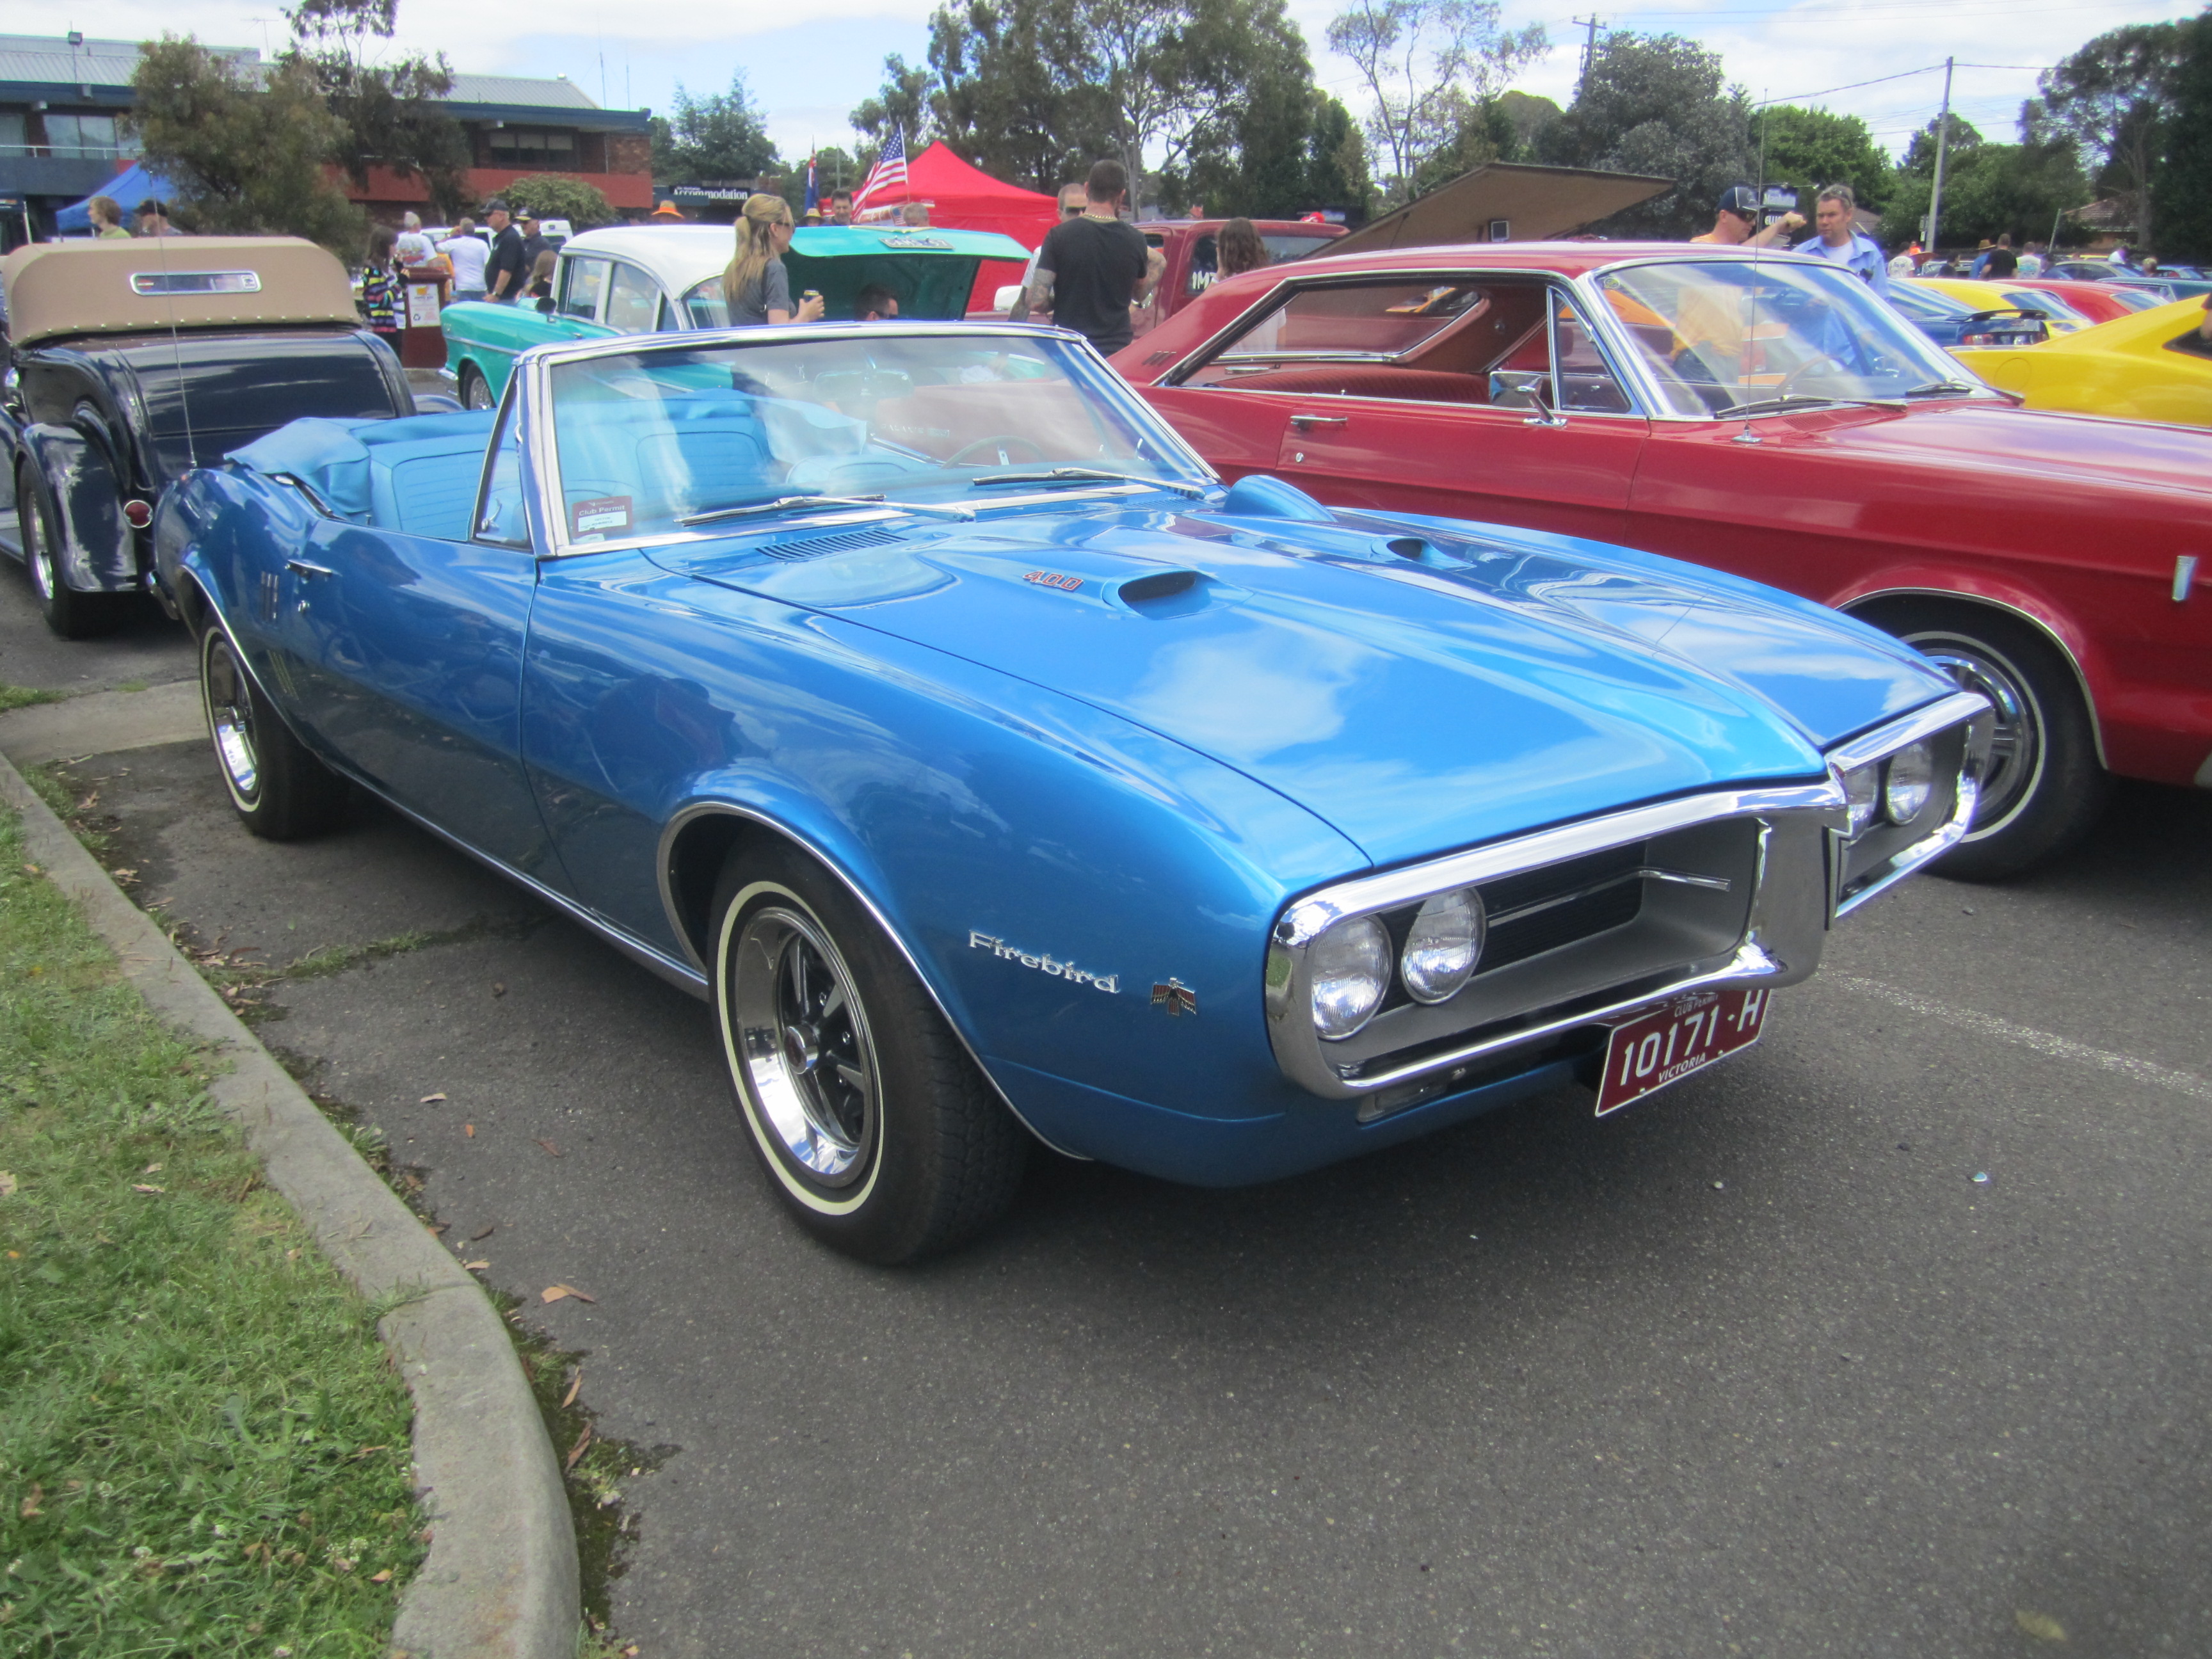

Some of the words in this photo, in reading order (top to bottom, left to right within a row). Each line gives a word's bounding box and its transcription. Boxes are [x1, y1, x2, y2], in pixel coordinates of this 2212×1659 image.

[598, 504, 625, 513] Permit
[1022, 570, 1084, 592] 400
[968, 929, 1121, 994] Firebird
[1674, 1000, 1694, 1018] CLUB
[1658, 1052, 1706, 1084] VICTORIA
